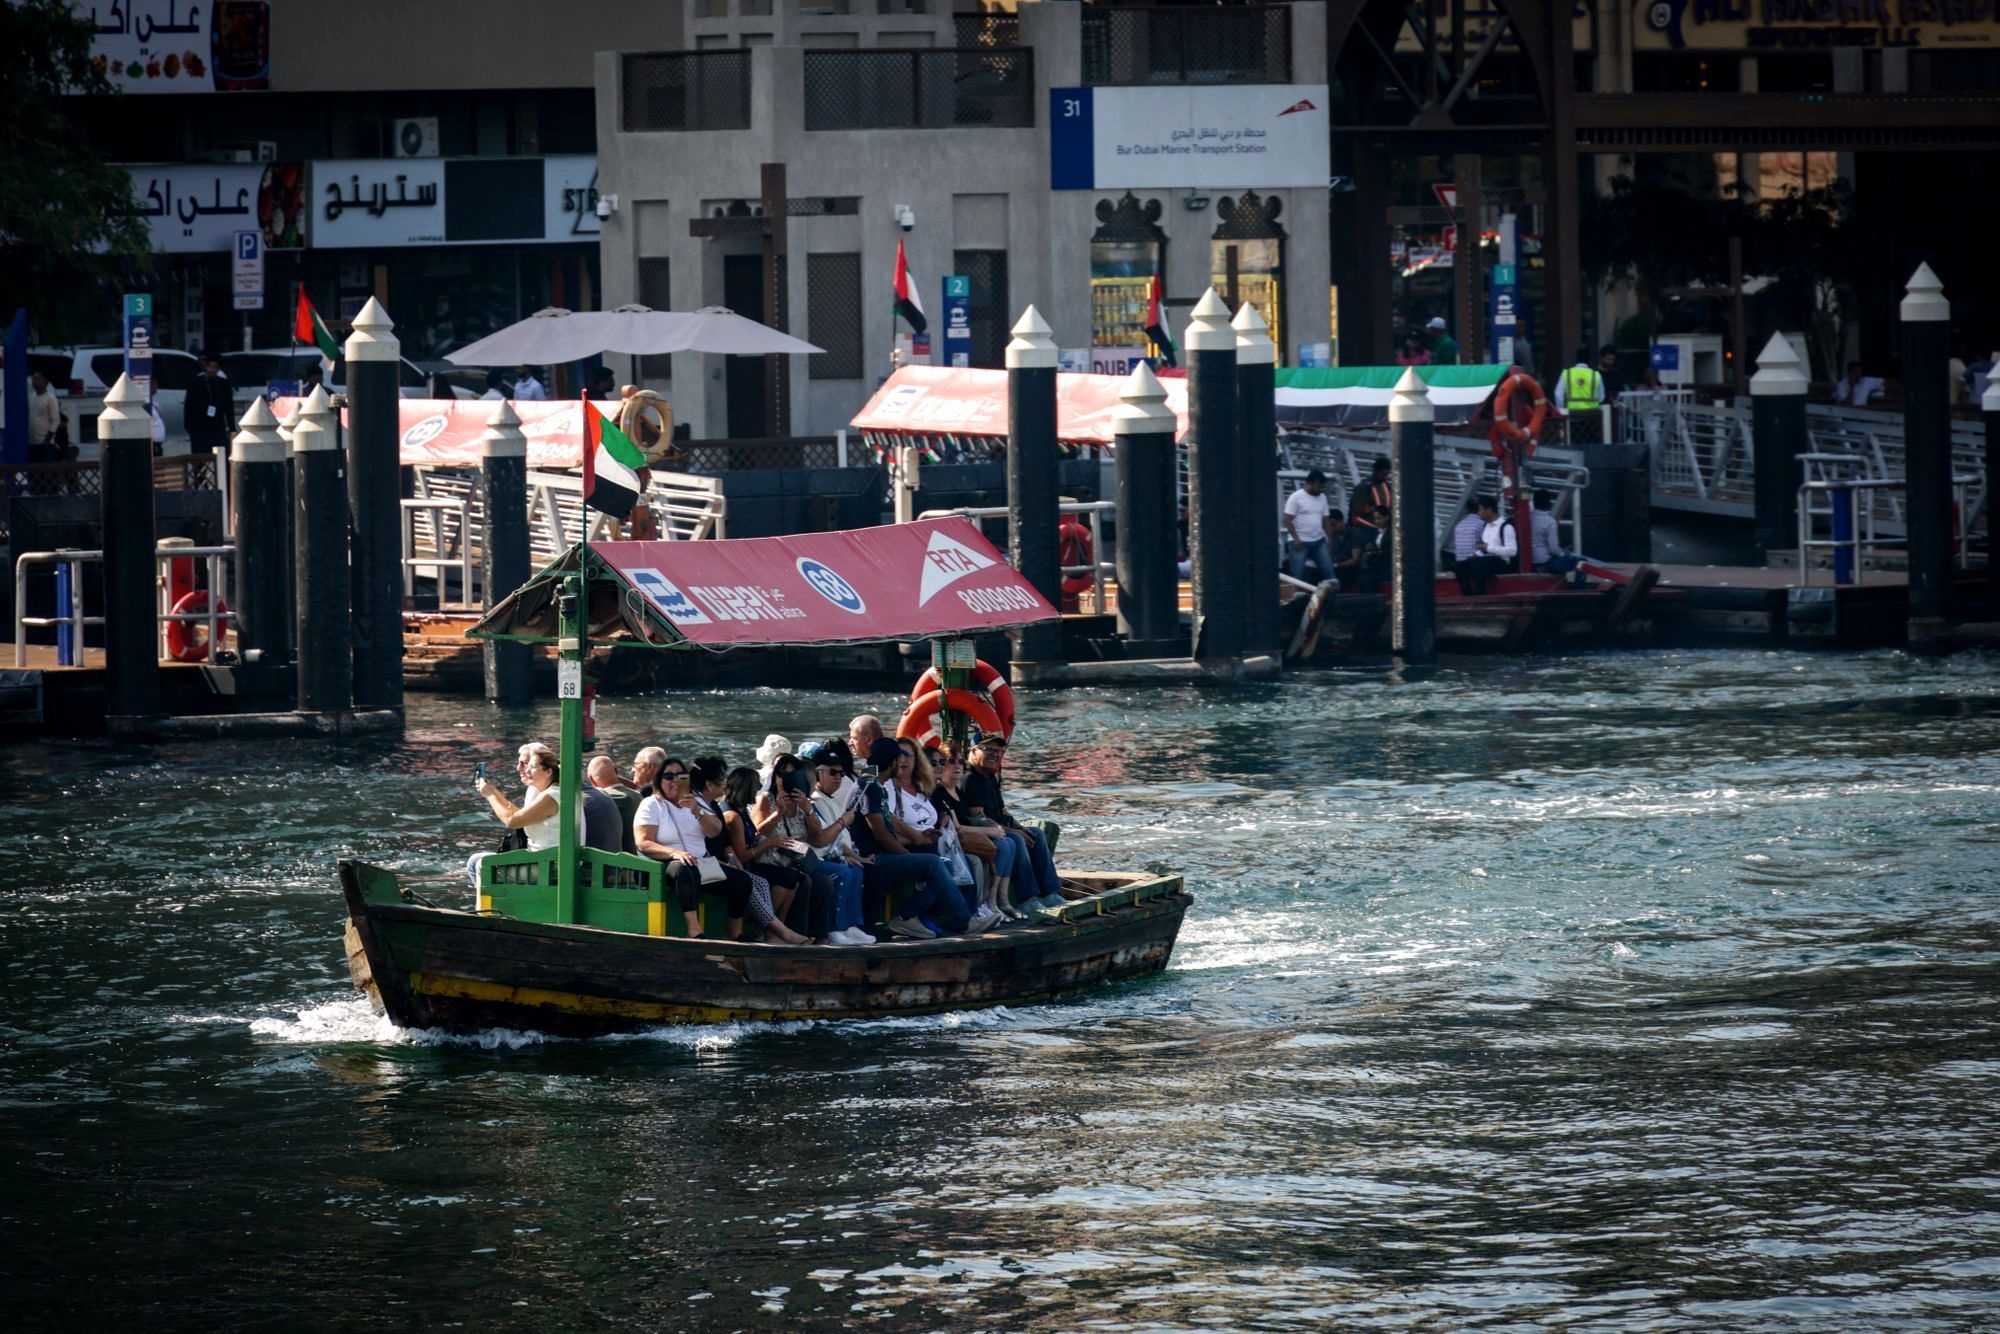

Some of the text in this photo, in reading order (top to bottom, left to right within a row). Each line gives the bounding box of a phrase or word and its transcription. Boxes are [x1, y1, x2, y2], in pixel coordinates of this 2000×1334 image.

[1063, 98, 1082, 118] 31
[1117, 143, 1267, 156] Bur Dubai Marine Transport Station
[177, 178, 249, 237] علي
[242, 235, 255, 258] P
[953, 280, 963, 293] 2
[135, 298, 145, 312] 3
[926, 549, 981, 574] RTA
[808, 568, 852, 603] 68
[957, 584, 1042, 615] 8009090
[780, 606, 808, 618] abra
[563, 682, 576, 696] 68
